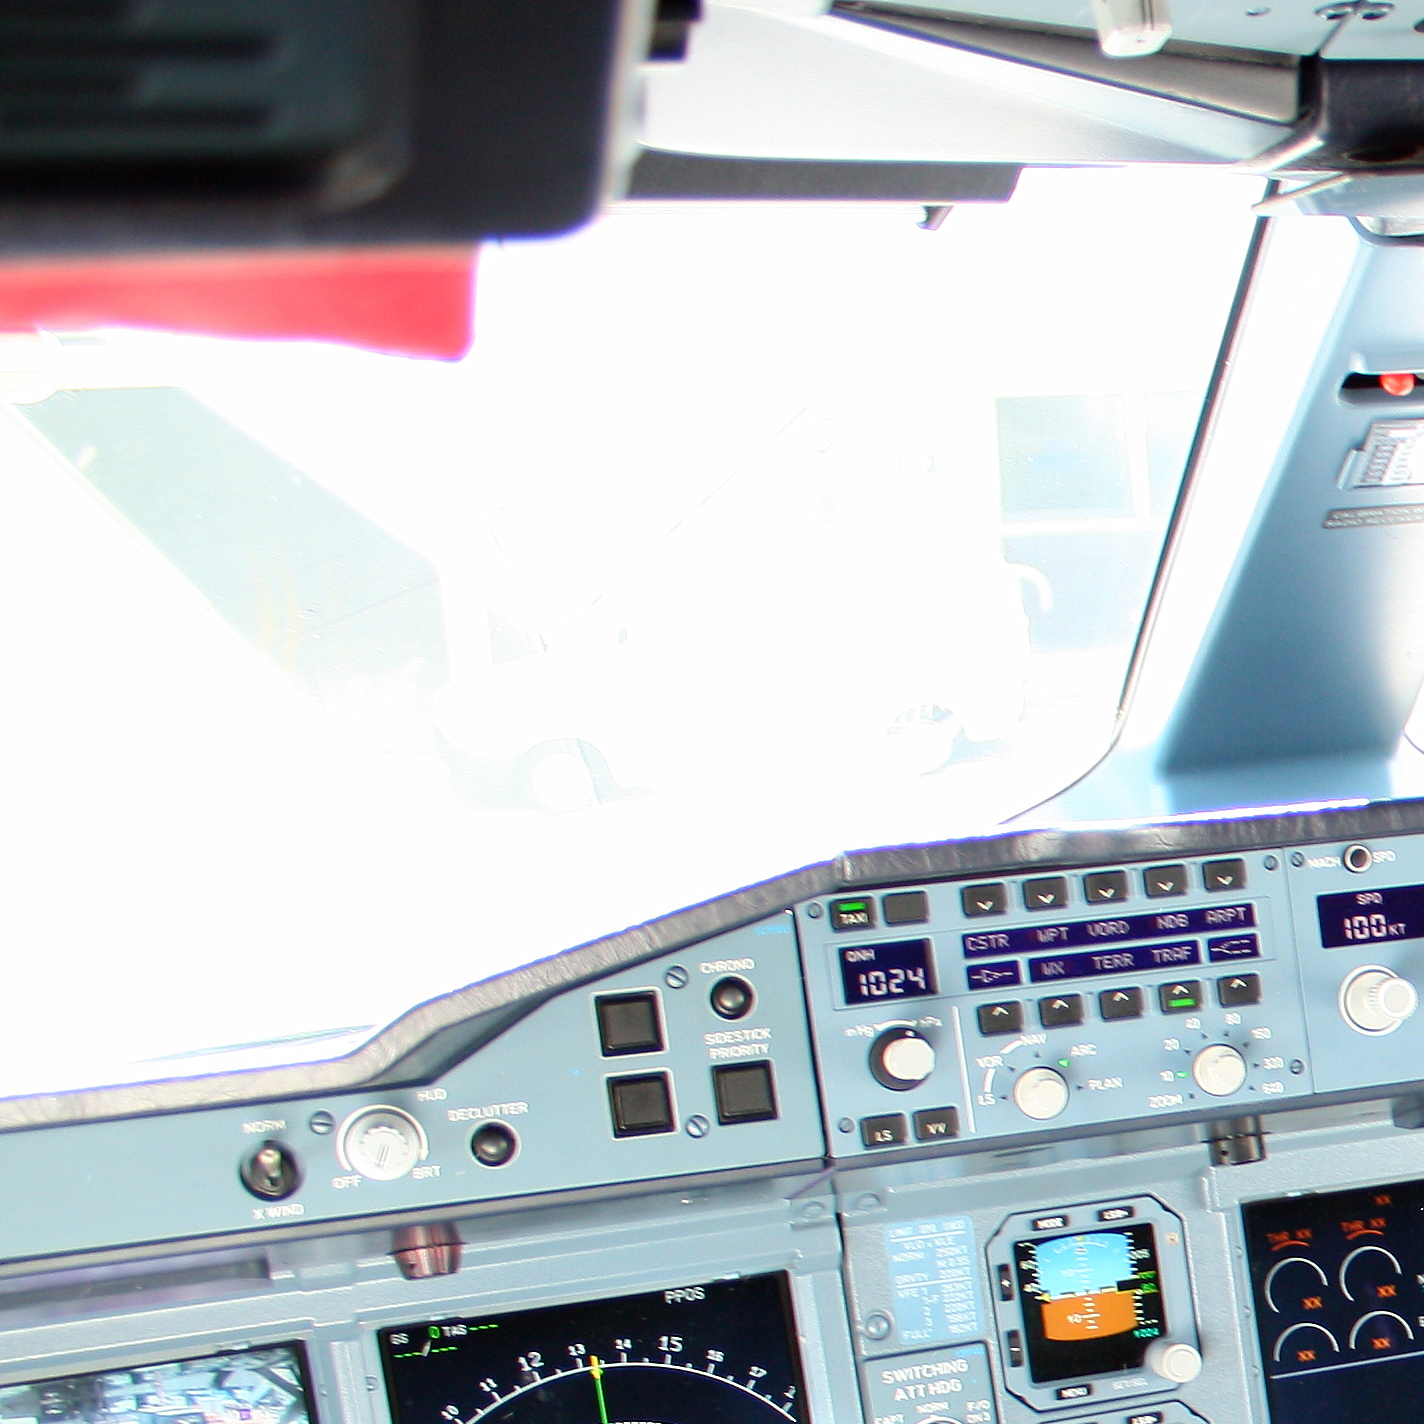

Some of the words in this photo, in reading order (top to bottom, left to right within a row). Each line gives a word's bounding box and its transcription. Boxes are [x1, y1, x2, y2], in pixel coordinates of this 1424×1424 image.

[840, 913, 869, 924] TAXI
[966, 934, 1010, 951] CSTR
[1156, 914, 1189, 930] NDB
[1205, 907, 1247, 924] ARPT
[1344, 917, 1387, 940] 100
[698, 958, 755, 974] CHRONO
[1092, 953, 1134, 970] TERR
[1152, 946, 1191, 963] TRAF
[859, 968, 926, 996] 1024
[1089, 1077, 1123, 1089] PLAN
[448, 1101, 529, 1122] DECLUTTER
[664, 1287, 705, 1304] PPOS
[567, 1344, 586, 1356] 13
[657, 1335, 683, 1352] 15
[516, 1351, 544, 1372] 12
[881, 1359, 968, 1383] SWITCHING
[894, 1385, 928, 1400] ATT
[930, 1379, 962, 1393] HDG
